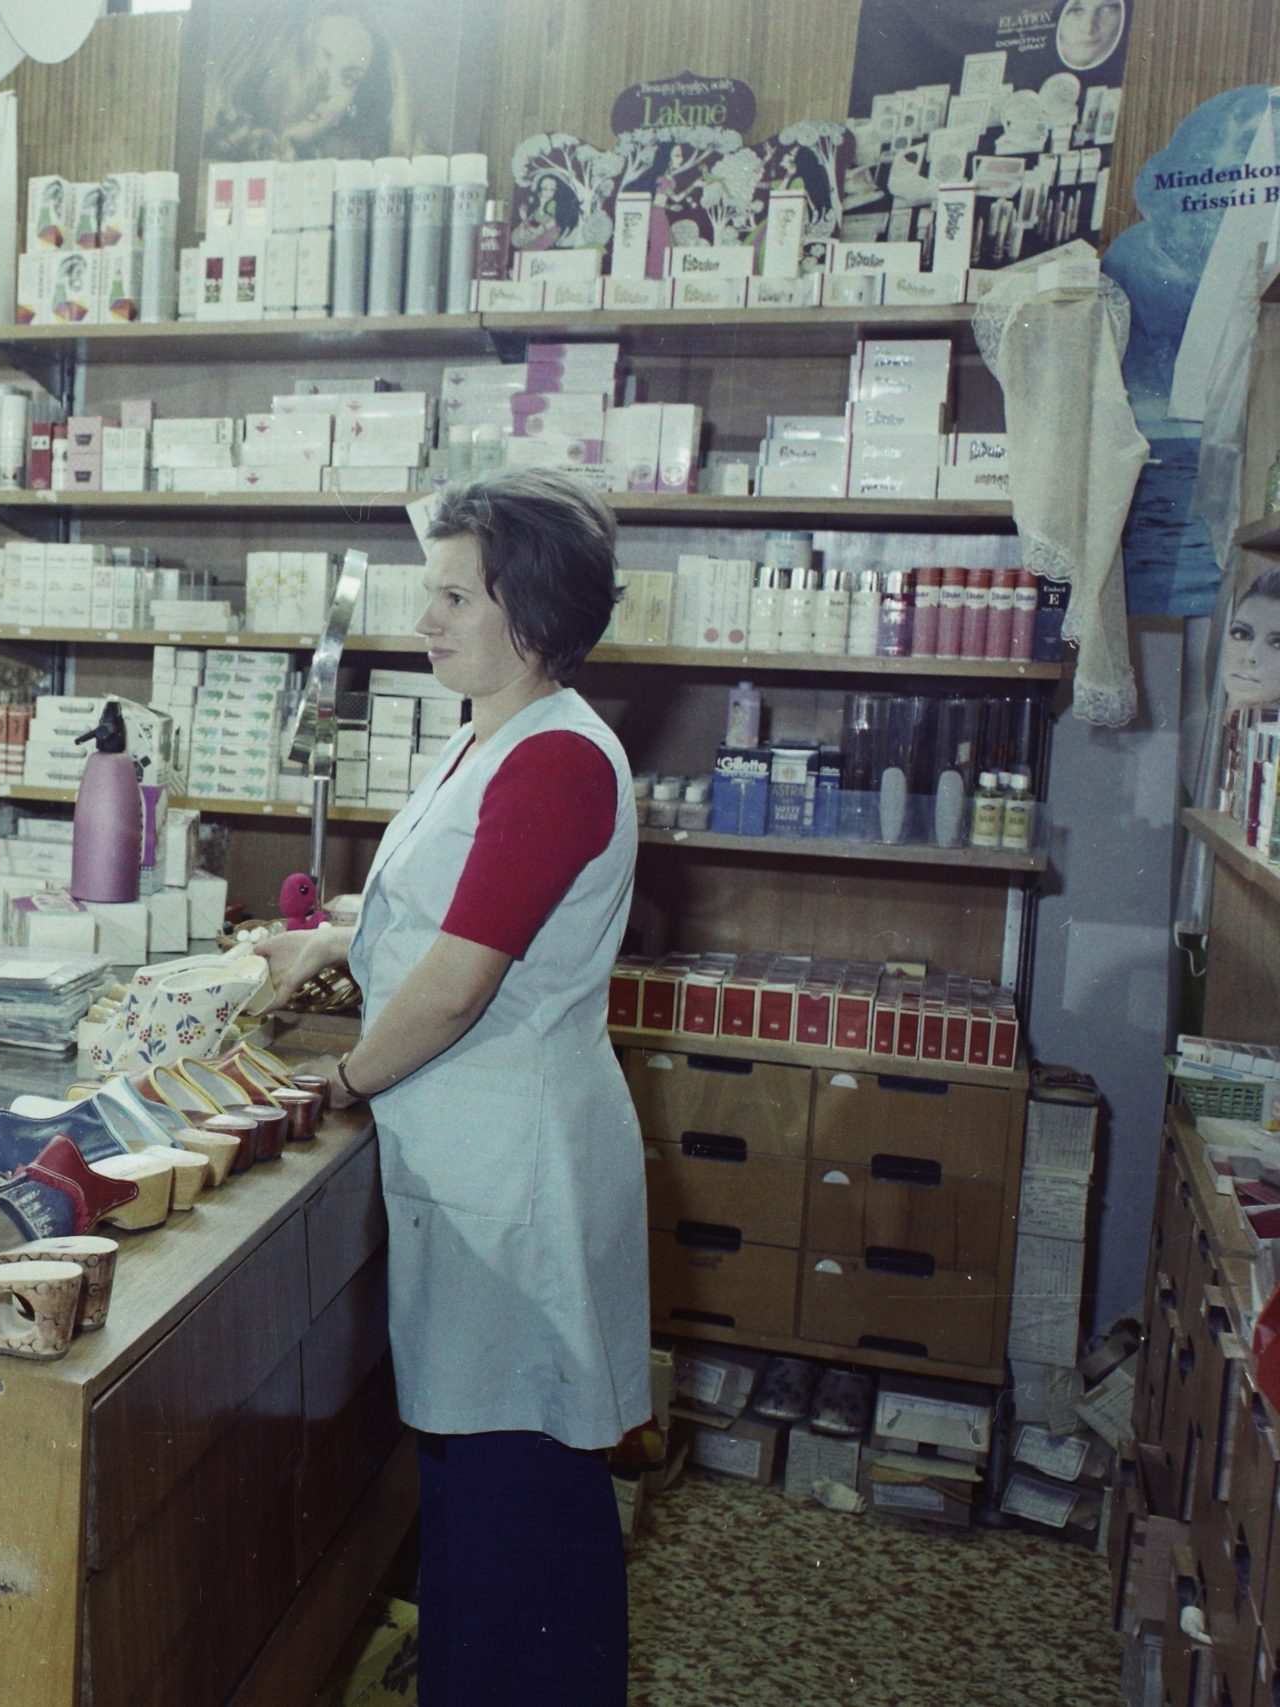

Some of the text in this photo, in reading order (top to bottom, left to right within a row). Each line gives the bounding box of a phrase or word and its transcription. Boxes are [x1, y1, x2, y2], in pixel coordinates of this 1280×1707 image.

[1181, 188, 1256, 212] frissíti
[1048, 593, 1060, 605] E
[721, 756, 768, 773] Gillette
